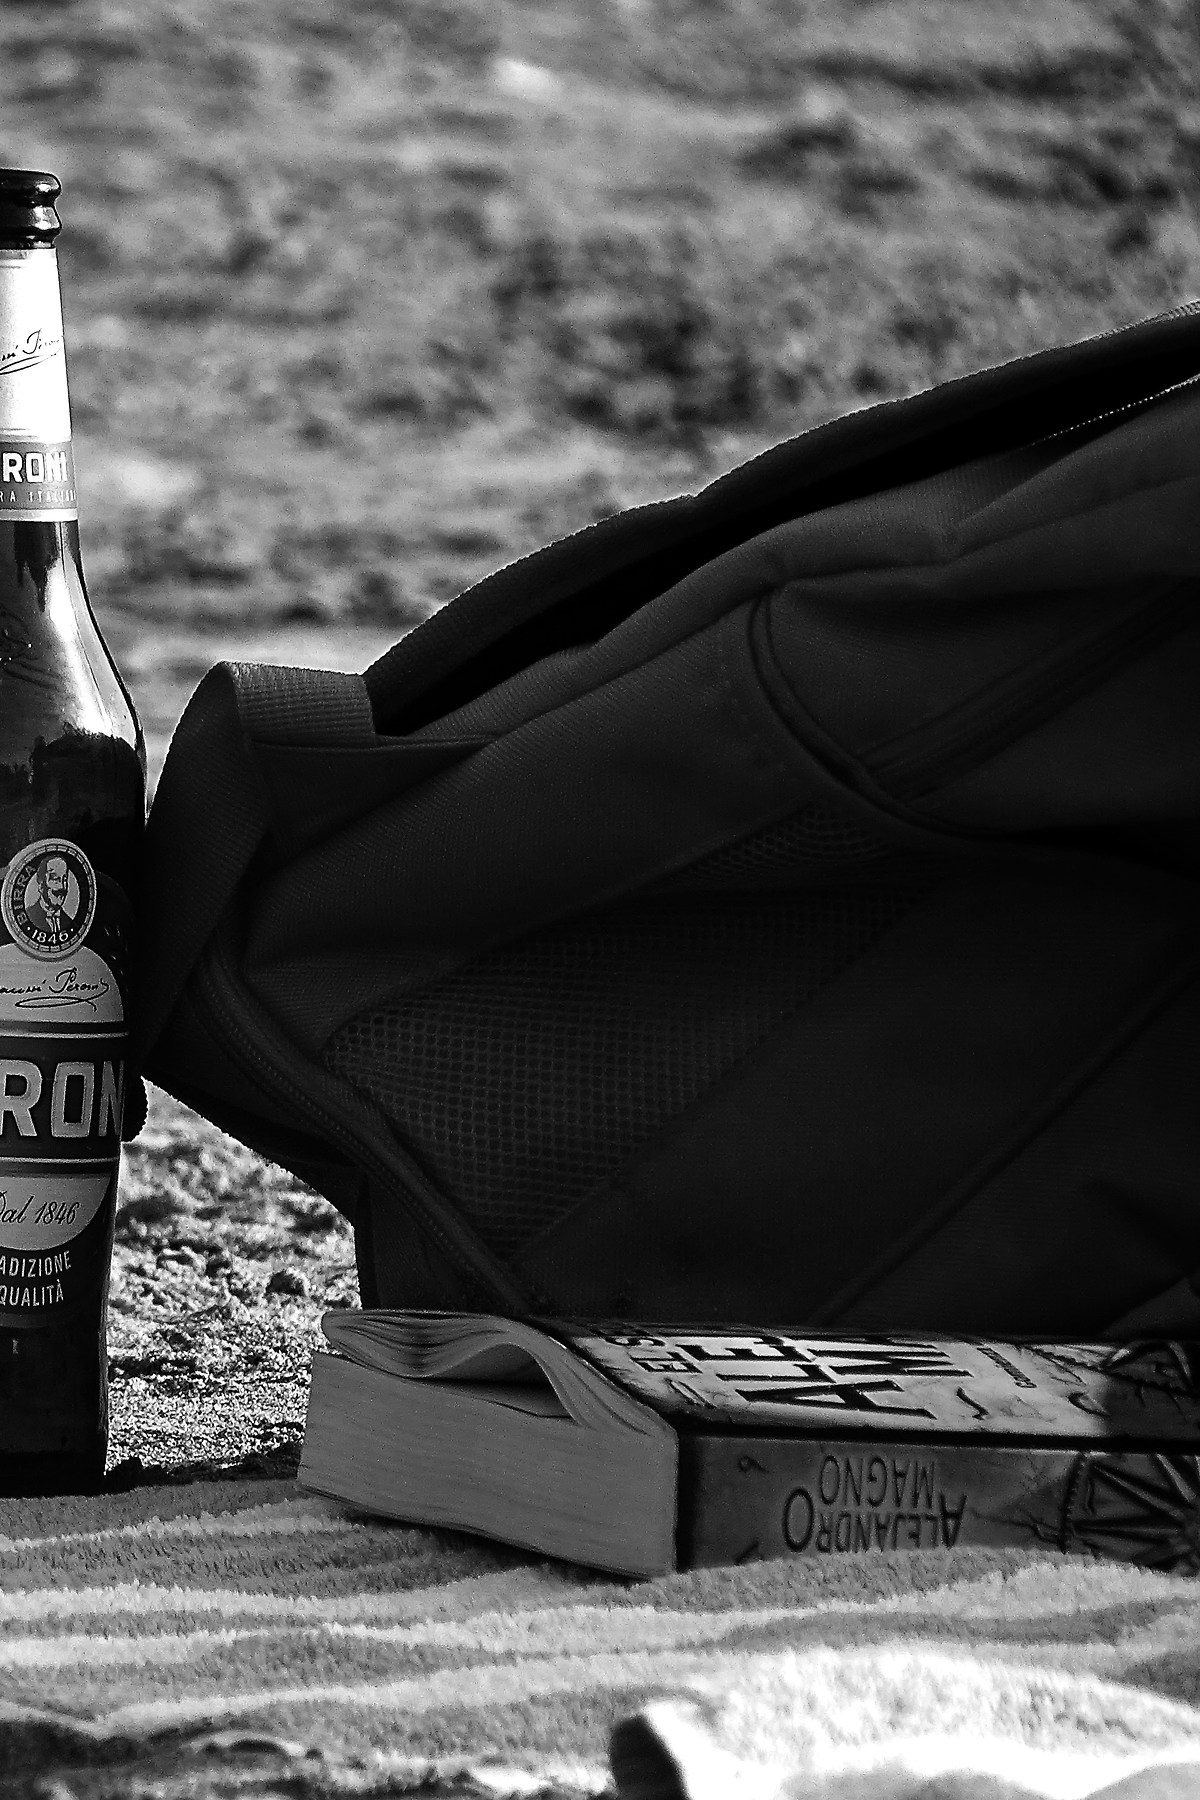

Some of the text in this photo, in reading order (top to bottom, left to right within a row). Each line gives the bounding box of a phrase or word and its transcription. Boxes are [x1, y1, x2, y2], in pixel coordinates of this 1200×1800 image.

[13, 865, 37, 926] BIRRA
[31, 929, 69, 944] 1846
[34, 1201, 80, 1225] 1846
[819, 1454, 936, 1508] MAGNO
[781, 1487, 968, 1553] ALEJANDRO
